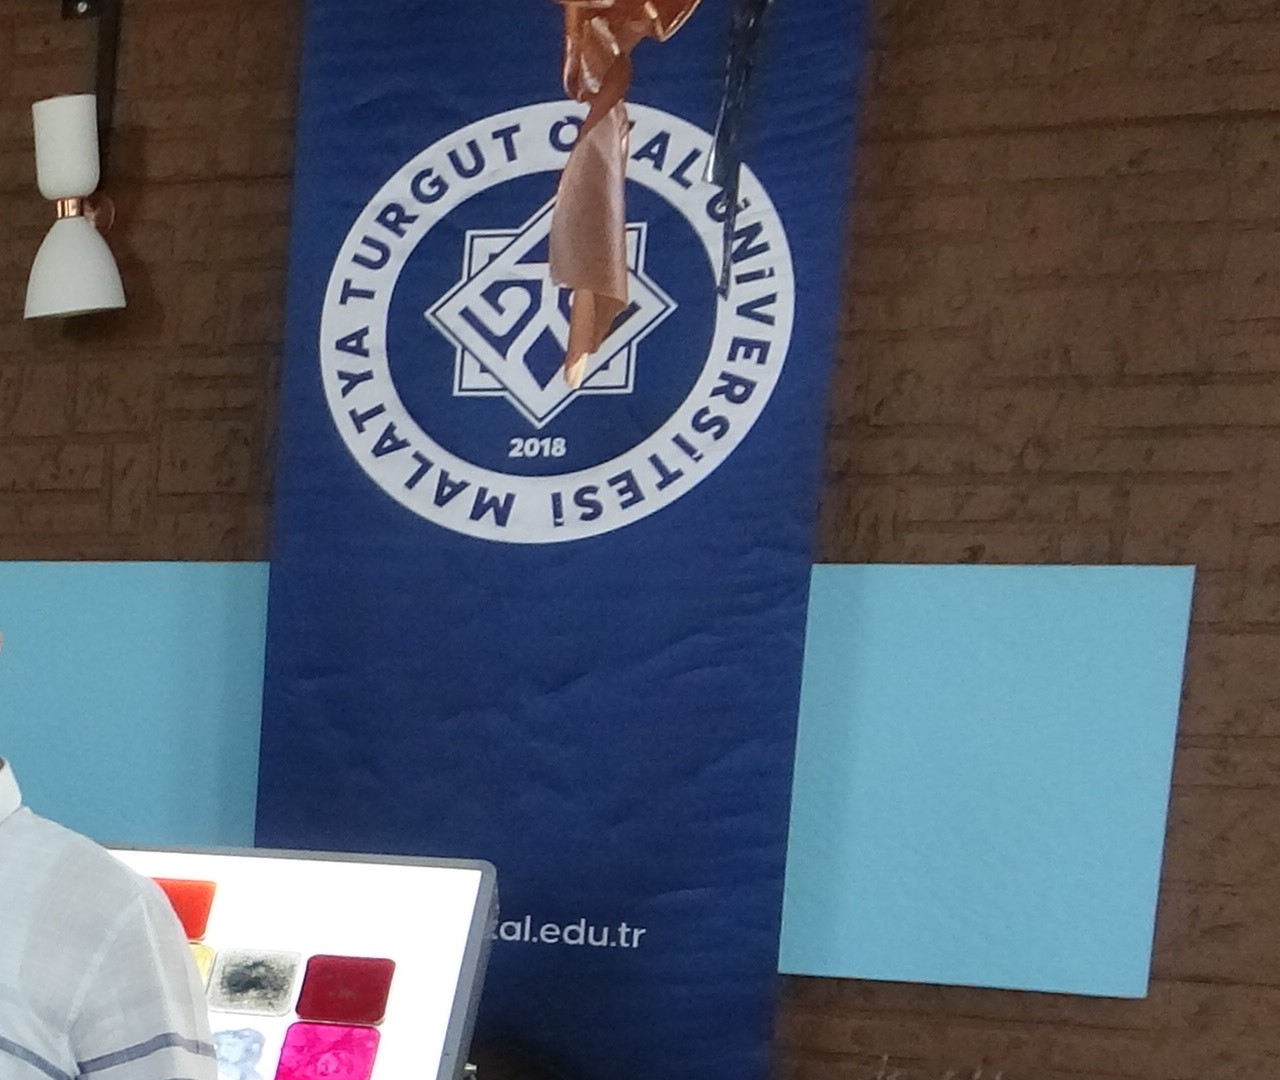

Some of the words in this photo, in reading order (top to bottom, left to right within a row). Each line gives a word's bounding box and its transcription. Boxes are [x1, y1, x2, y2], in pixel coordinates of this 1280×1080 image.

[548, 115, 703, 190] ÖAL
[339, 124, 522, 307] TURGUT
[335, 326, 516, 527] MALATYA
[508, 437, 567, 458] 2018
[493, 914, 647, 948] al.edu.tr
